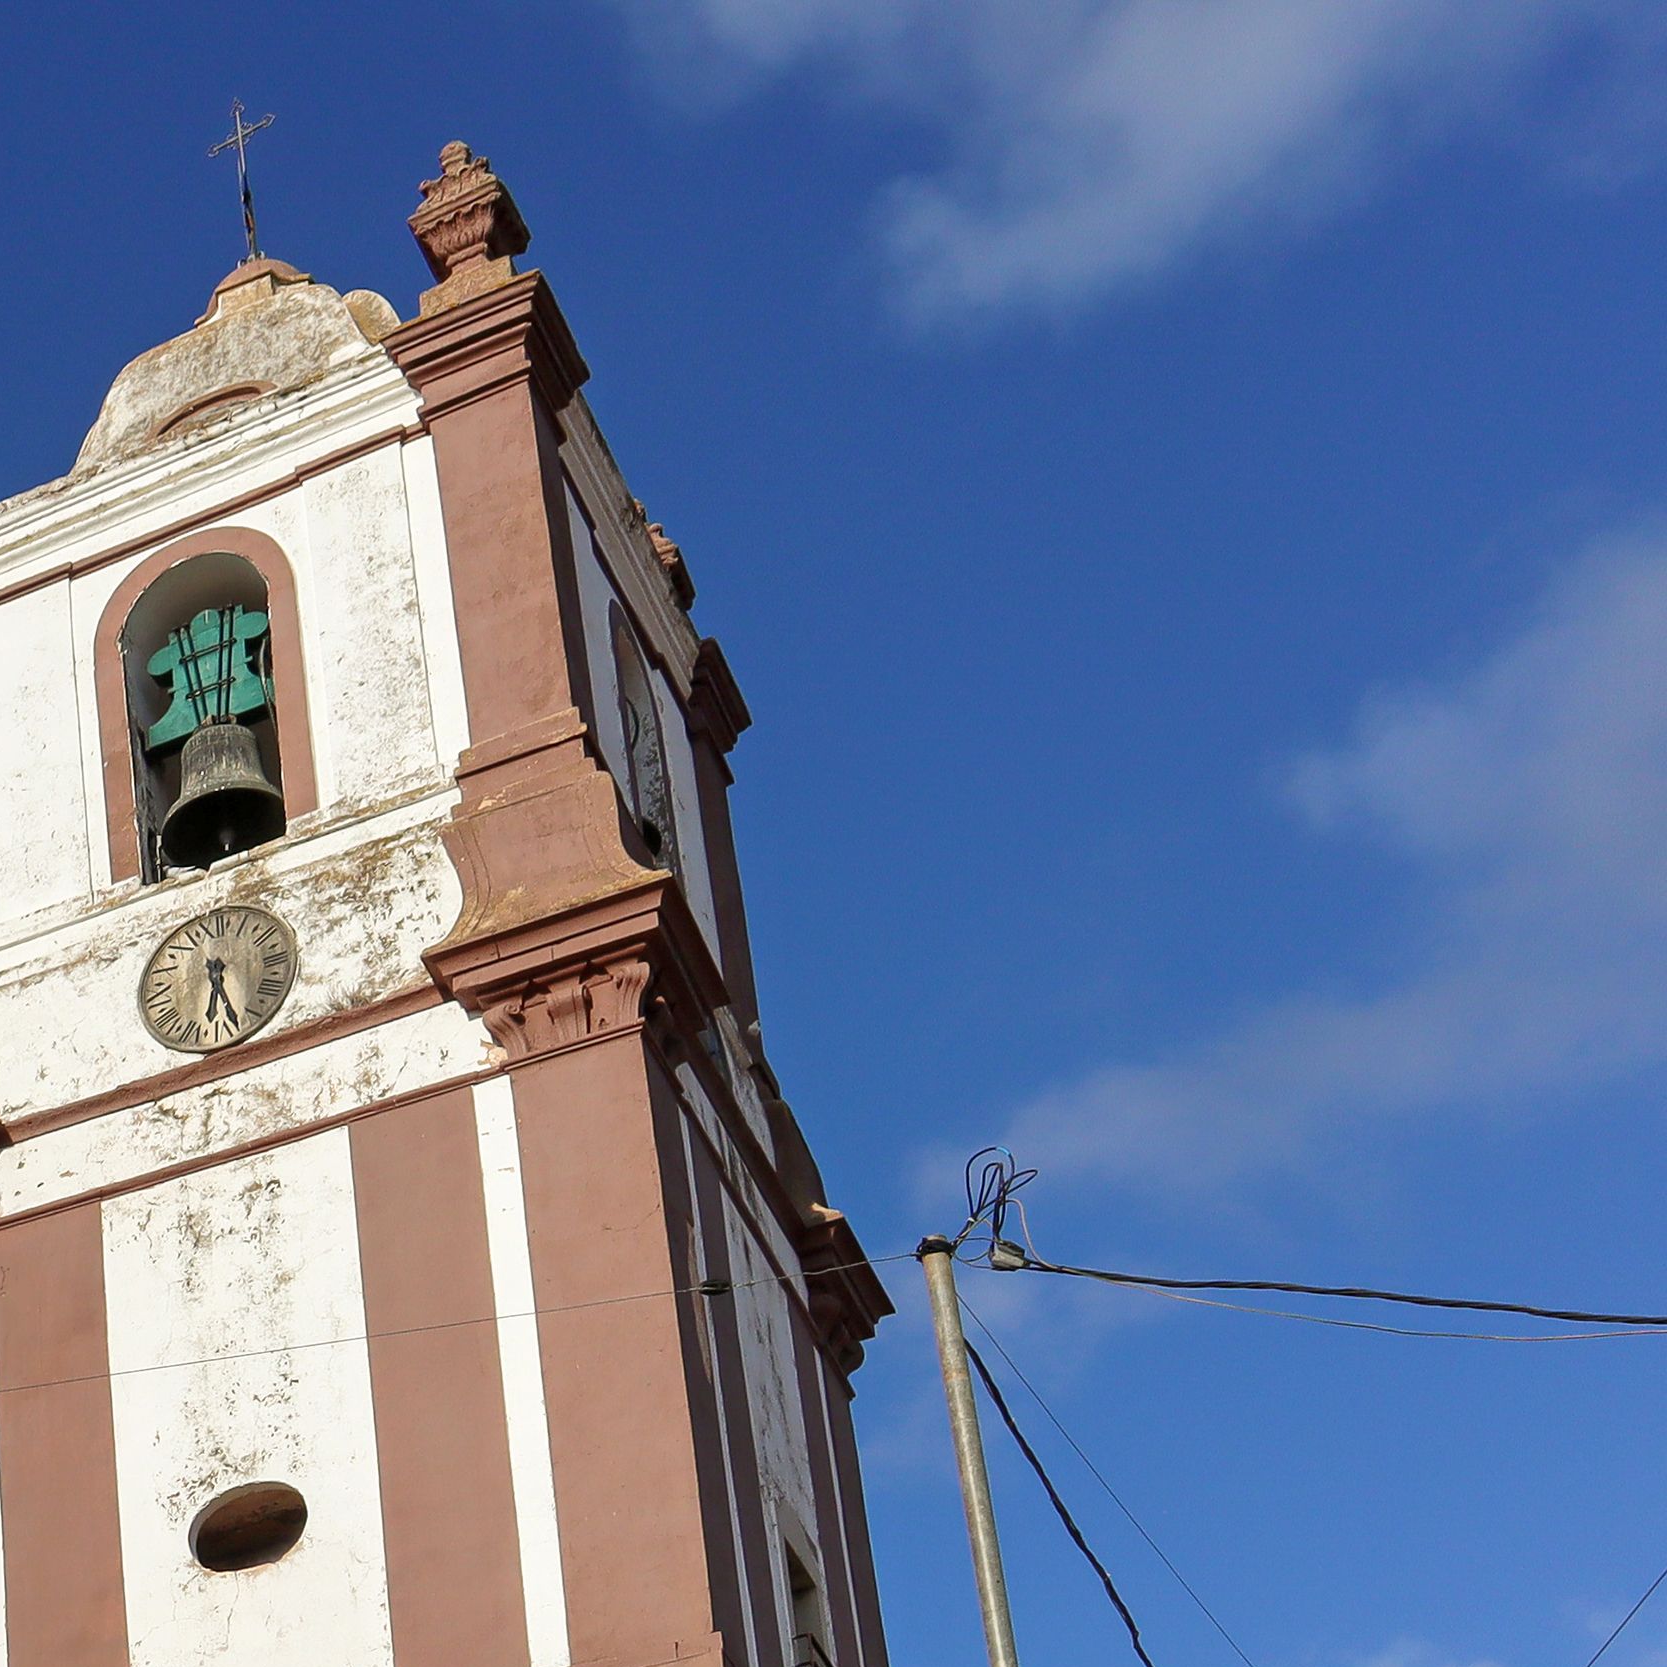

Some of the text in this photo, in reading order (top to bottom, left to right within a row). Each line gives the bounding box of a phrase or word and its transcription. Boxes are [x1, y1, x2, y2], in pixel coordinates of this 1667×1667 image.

[236, 914, 250, 938] I
[253, 924, 278, 947] II
[262, 950, 289, 968] III
[257, 978, 285, 997] IIII
